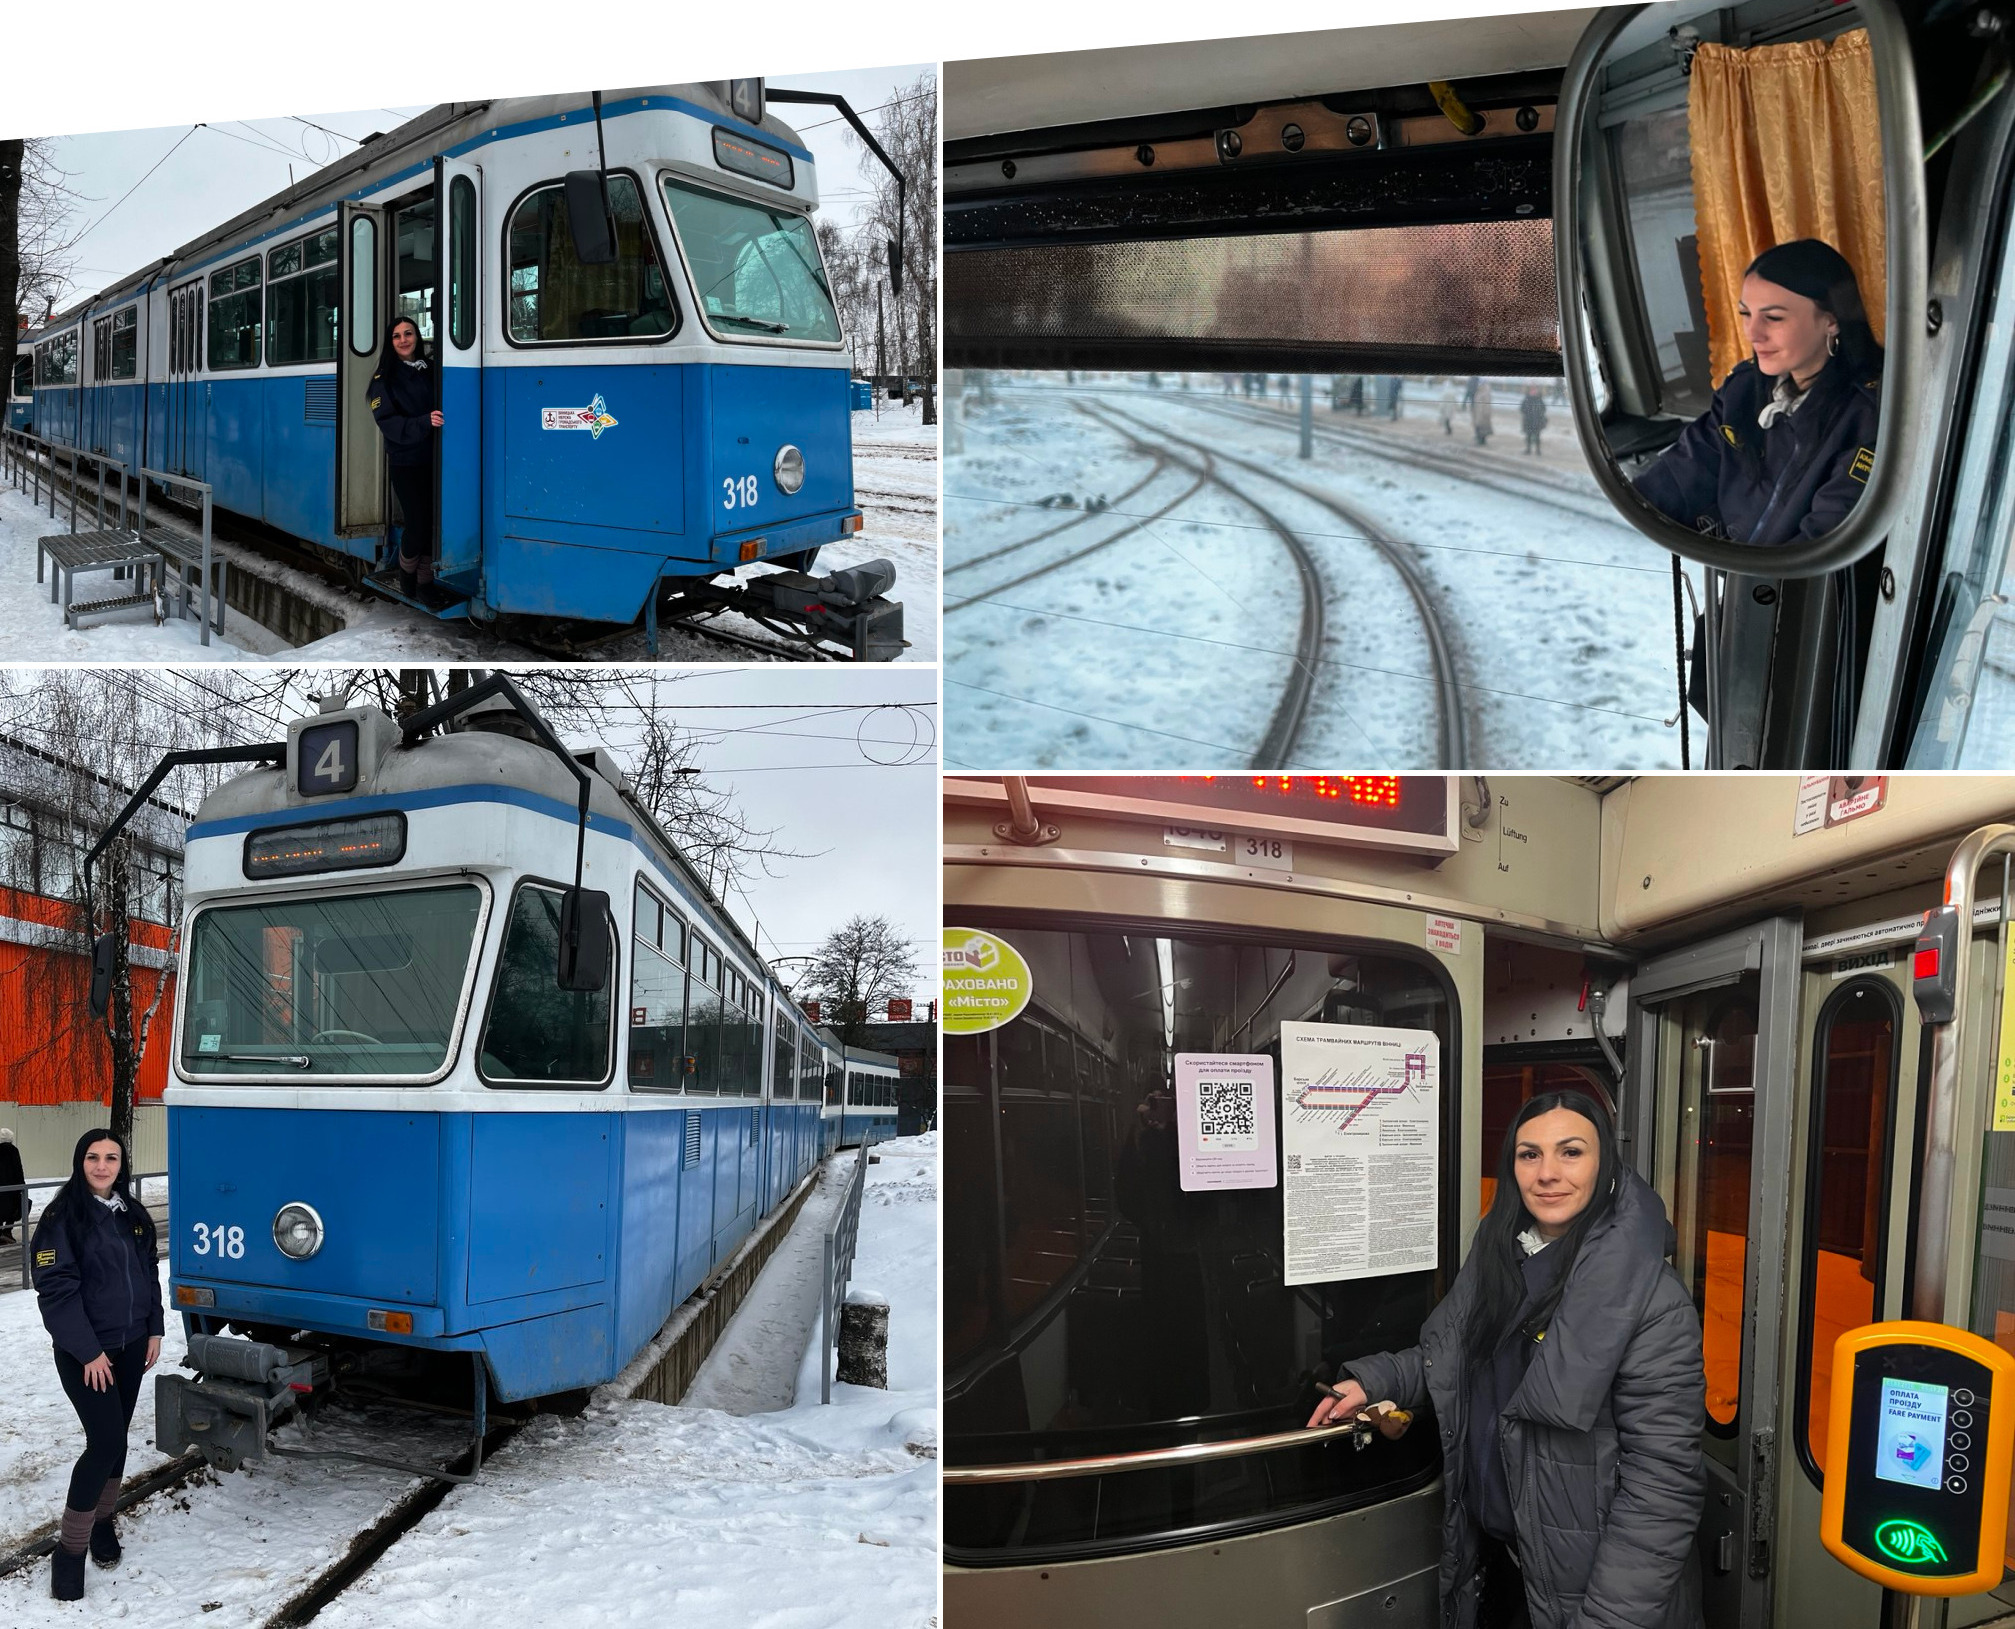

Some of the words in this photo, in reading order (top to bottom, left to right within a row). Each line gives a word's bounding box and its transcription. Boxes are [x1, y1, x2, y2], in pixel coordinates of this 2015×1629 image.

[735, 79, 751, 113] 4
[723, 475, 758, 510] 318
[314, 739, 345, 783] 4
[1499, 795, 1509, 806] Zu
[1838, 793, 1870, 809] АВАРІЙНЕ
[1840, 803, 1866, 817] ГАЛЬМО
[1502, 826, 1528, 843] Lüftung
[1246, 838, 1283, 859] 318
[1498, 862, 1509, 872] Auf
[1821, 938, 1836, 948] двері
[1836, 931, 1874, 944] зачиняються
[1875, 922, 1915, 936] автоматично
[1972, 905, 2001, 917] ідніжки
[943, 950, 965, 962] ТО
[1838, 951, 1889, 972] ВИХІД
[943, 978, 1019, 990] АХОВАНО
[948, 996, 1009, 1007] «Місто»
[1316, 1037, 1352, 1045] ТРАМВАЙНИХ
[193, 1222, 245, 1259] 318
[1890, 1390, 1919, 1400] ОПЛАТА
[1889, 1398, 1922, 1409] ПРОЇЗДУ
[1889, 1409, 1906, 1417] FARE
[1907, 1411, 1941, 1422] PAYMENT
